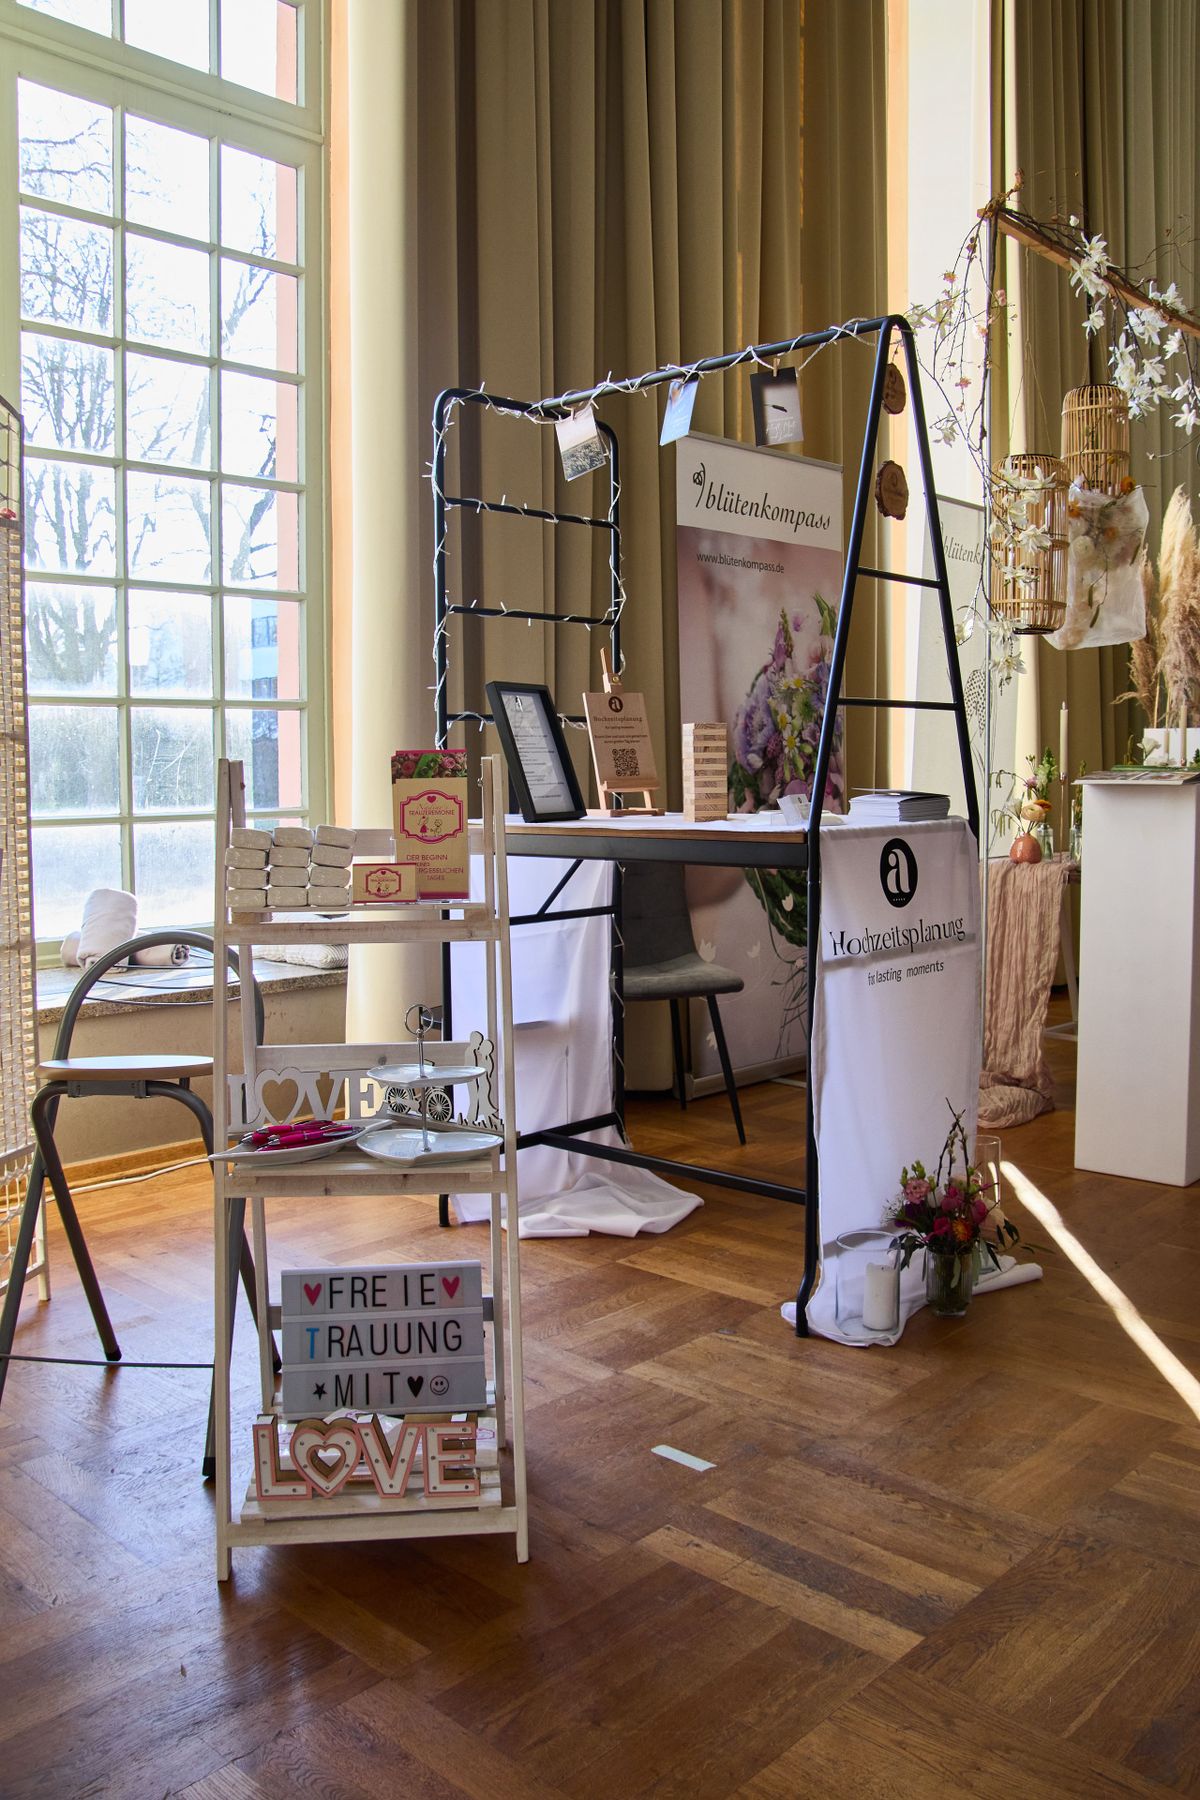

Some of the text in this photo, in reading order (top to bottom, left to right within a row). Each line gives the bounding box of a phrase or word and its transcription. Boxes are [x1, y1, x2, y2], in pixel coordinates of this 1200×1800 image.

[705, 481, 831, 533] blütenkompass
[696, 552, 785, 574] www.blütenkompass.de
[943, 535, 983, 565] blütenk
[829, 917, 966, 956] Hochzeitsplanung
[876, 967, 902, 982] lasting
[906, 960, 944, 978] moments
[328, 1273, 436, 1309] FREIE
[305, 1319, 463, 1360] TRAUUNG
[334, 1371, 401, 1407] MIT
[252, 1414, 481, 1501] LOVE
